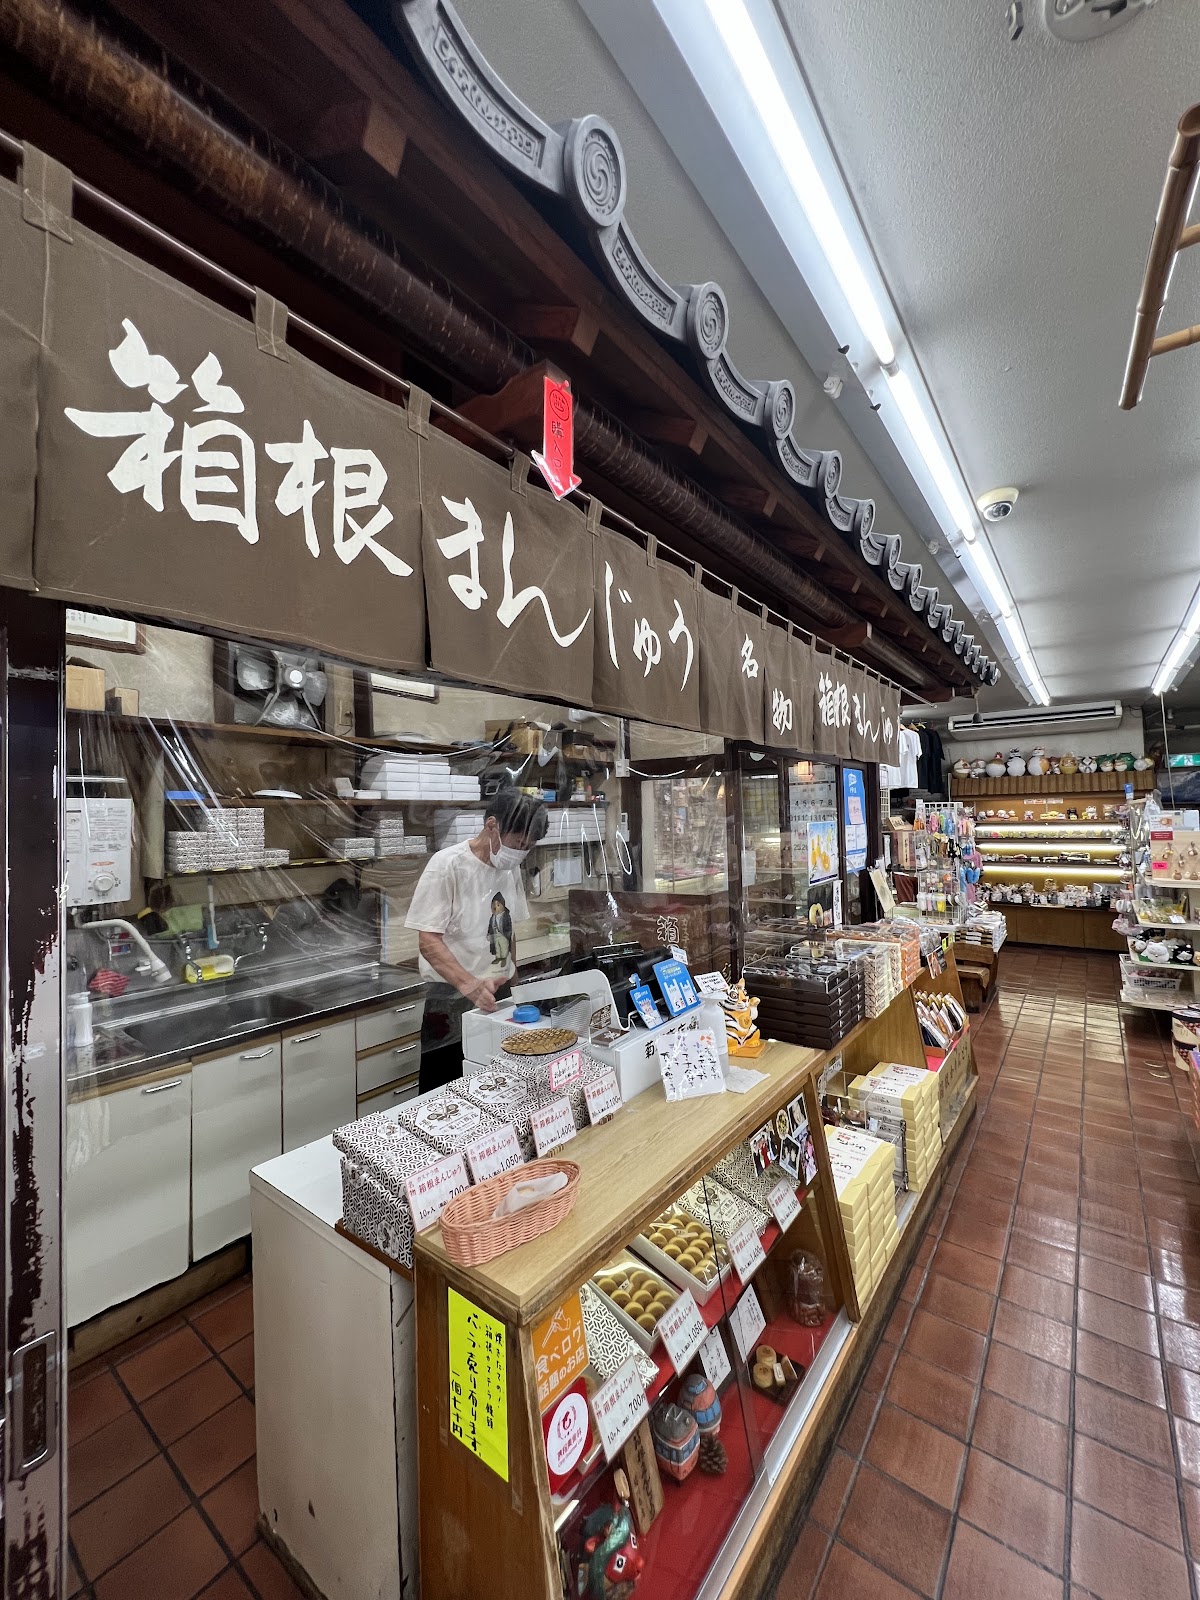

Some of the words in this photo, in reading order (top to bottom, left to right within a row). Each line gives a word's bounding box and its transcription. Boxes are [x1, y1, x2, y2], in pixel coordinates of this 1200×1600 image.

[64, 318, 694, 692] 箱根まんじゅう
[741, 633, 793, 735] 名物
[818, 672, 900, 745] 箱根まんじゅ
[419, 1164, 462, 1194] 箱根まんじゅう
[536, 1322, 582, 1381] 食べログ
[538, 1345, 585, 1402] 話題のお店
[451, 1370, 464, 1439] 一個七十円
